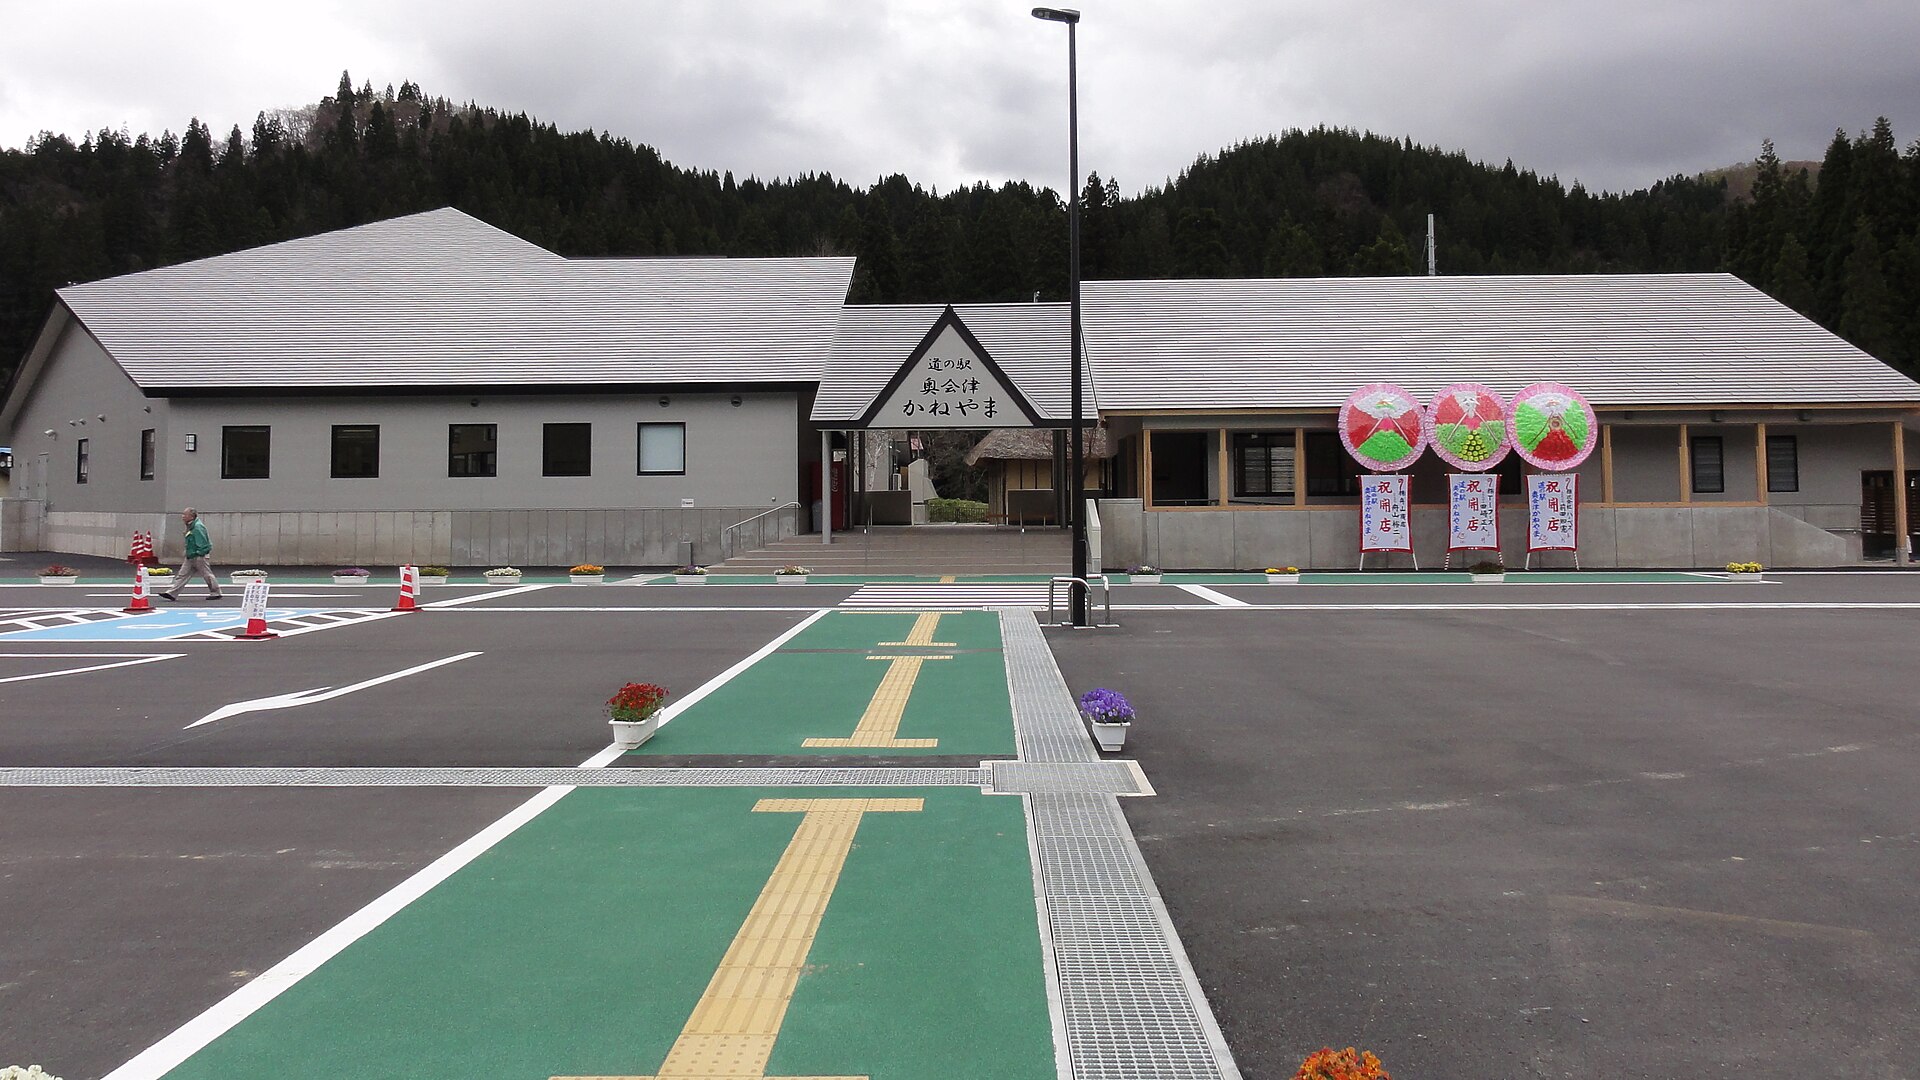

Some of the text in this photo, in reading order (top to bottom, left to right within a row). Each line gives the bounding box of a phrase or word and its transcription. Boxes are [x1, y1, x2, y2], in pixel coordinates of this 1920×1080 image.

[927, 357, 972, 372] 道の駅
[920, 376, 981, 395] 奥会津
[902, 396, 998, 419] かねやま
[1378, 481, 1393, 533] 祝開店
[1466, 480, 1482, 532] 祝開店
[1546, 481, 1561, 532] 祝開店
